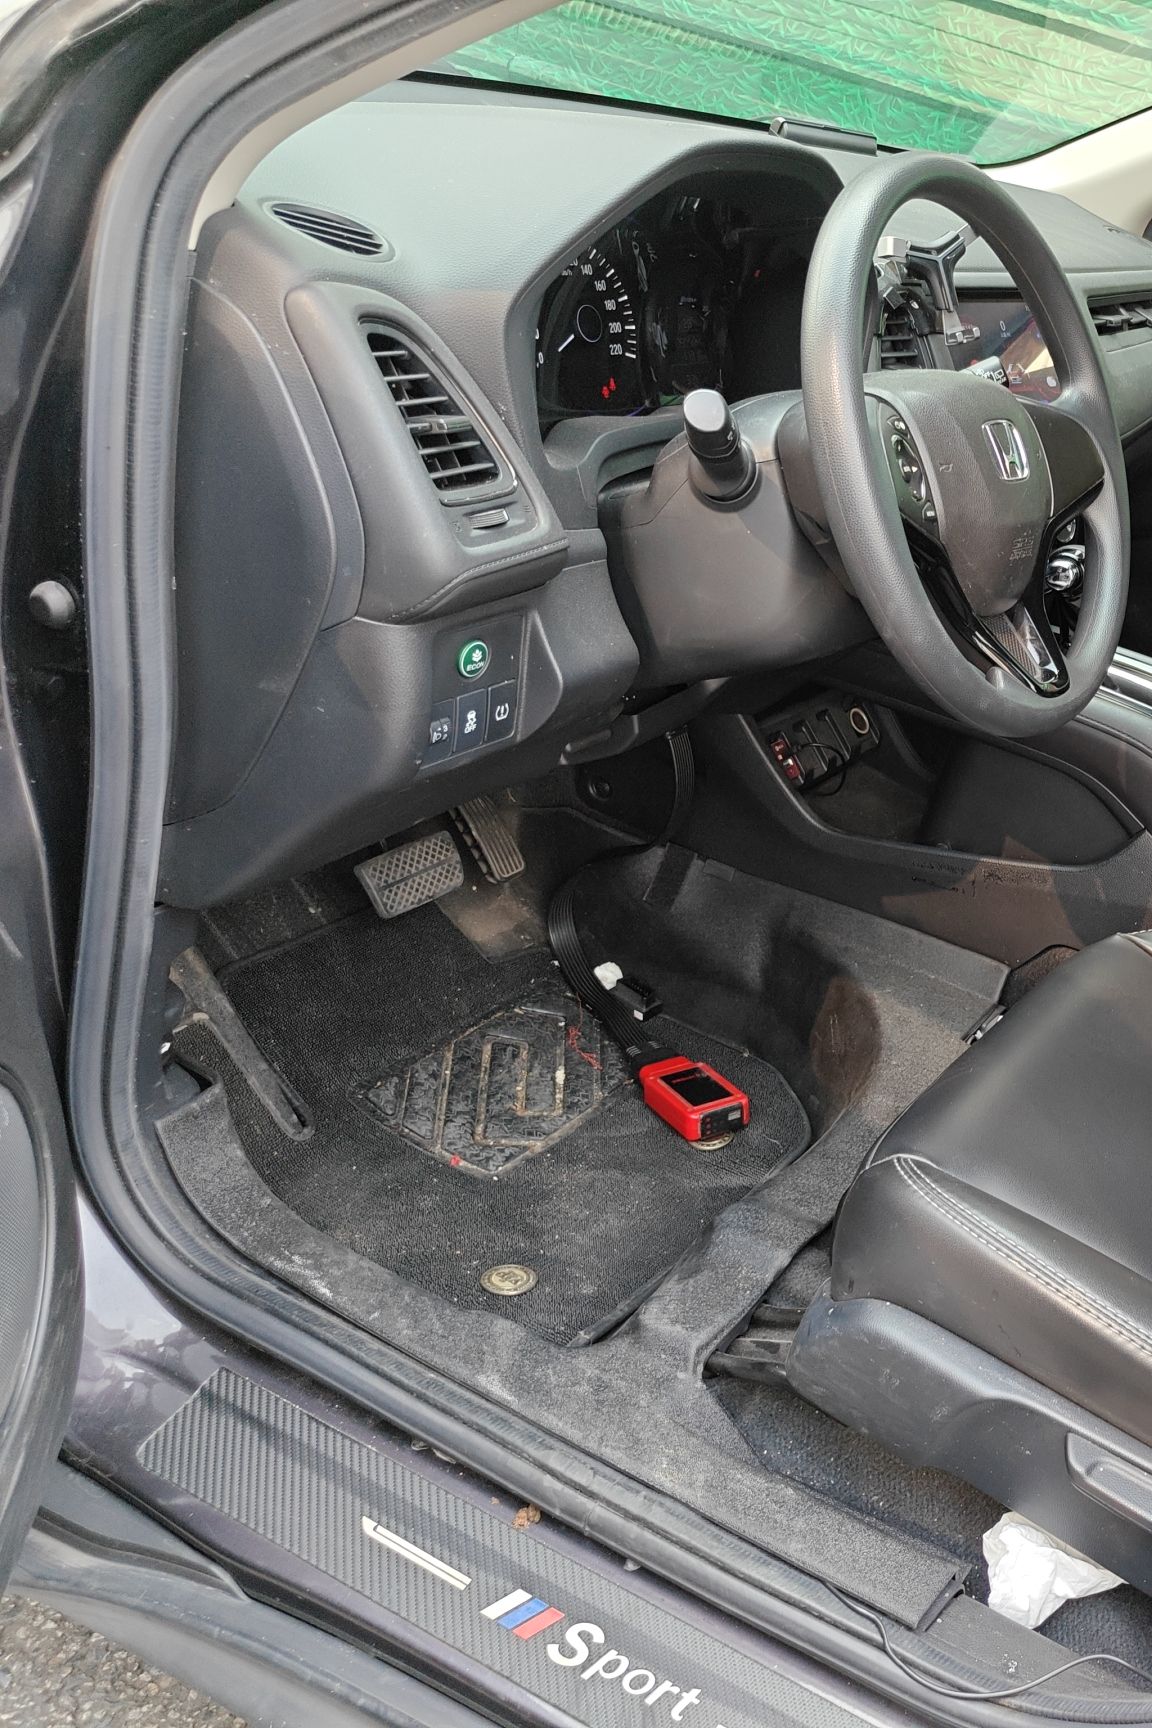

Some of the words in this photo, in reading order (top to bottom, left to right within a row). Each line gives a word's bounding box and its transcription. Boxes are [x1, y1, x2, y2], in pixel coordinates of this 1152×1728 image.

[581, 264, 593, 276] 140
[594, 280, 607, 292] 160
[604, 300, 616, 311] 180
[609, 322, 622, 334] 200
[609, 344, 623, 355] 220
[466, 661, 485, 672] ECON
[464, 724, 477, 734] OFF
[546, 1621, 702, 1723] Sport
